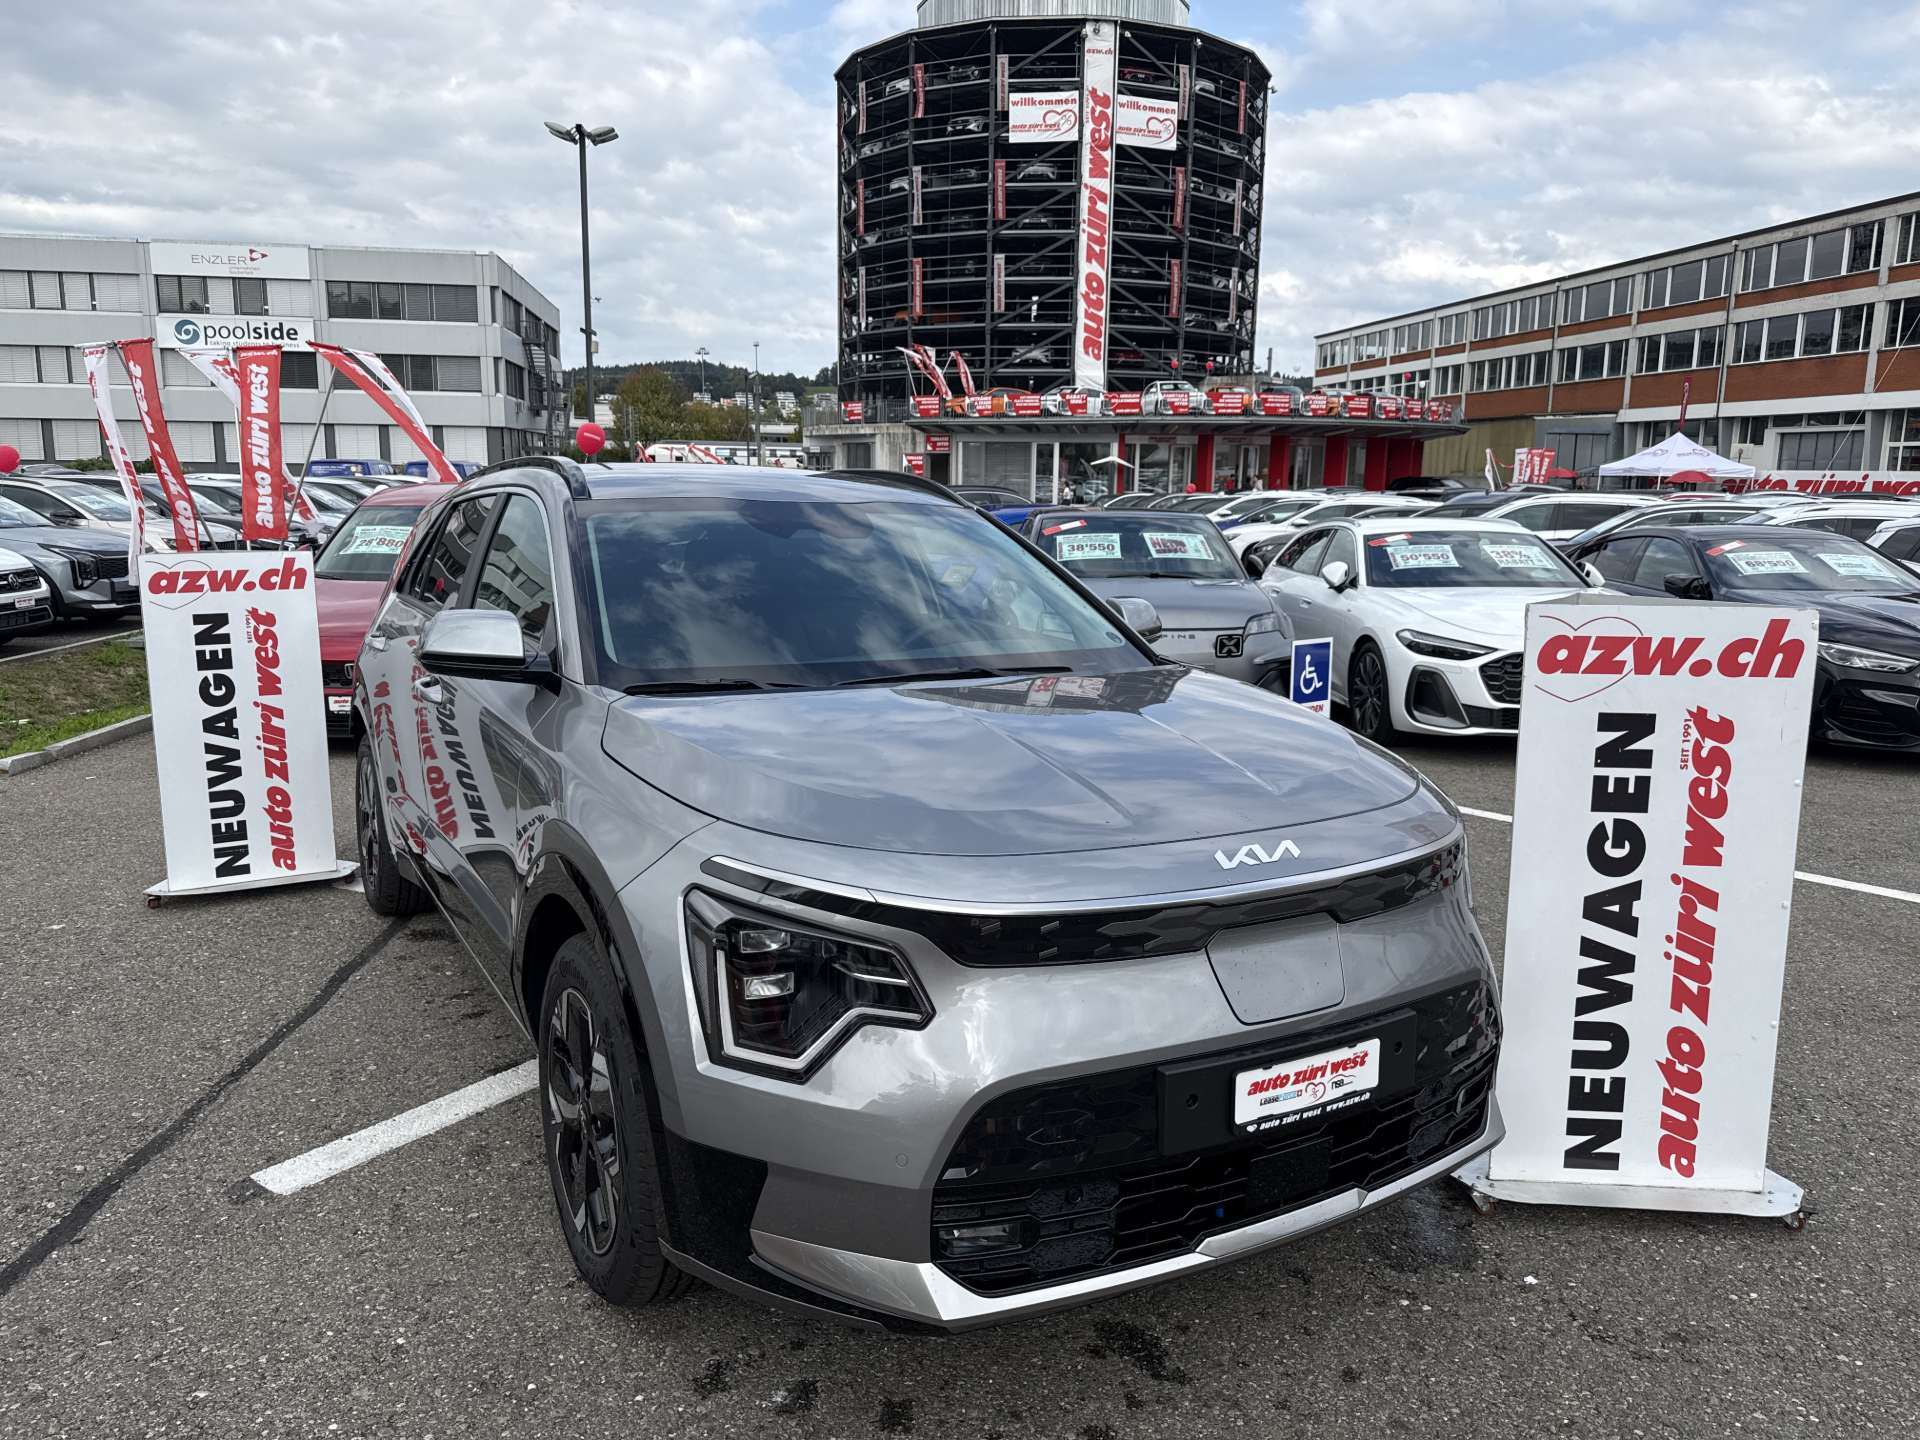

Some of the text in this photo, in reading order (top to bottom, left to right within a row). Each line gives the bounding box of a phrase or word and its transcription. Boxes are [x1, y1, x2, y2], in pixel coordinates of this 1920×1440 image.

[1011, 97, 1077, 106] willkommen
[1118, 100, 1176, 114] willkommen
[1082, 87, 1112, 362] auto züri west
[192, 254, 247, 265] ENZLER
[204, 321, 298, 345] poolside
[247, 363, 274, 529] auto züri west
[1871, 478, 1920, 496] we
[148, 557, 307, 595] azw.ch
[1400, 553, 1450, 561] 50'550
[1537, 618, 1805, 678] azw.ch
[192, 613, 251, 878] NEUWAGEN
[246, 607, 296, 871] auto züri west
[1680, 718, 1693, 770] SEIT 1991
[1564, 712, 1657, 1171] NEUWAGEN
[1656, 705, 1735, 1178] auto züri west
[1248, 1050, 1369, 1096] auto züri west
[1260, 1120, 1280, 1131] auto
[1282, 1113, 1300, 1125] züri
[1303, 1107, 1322, 1120] west
